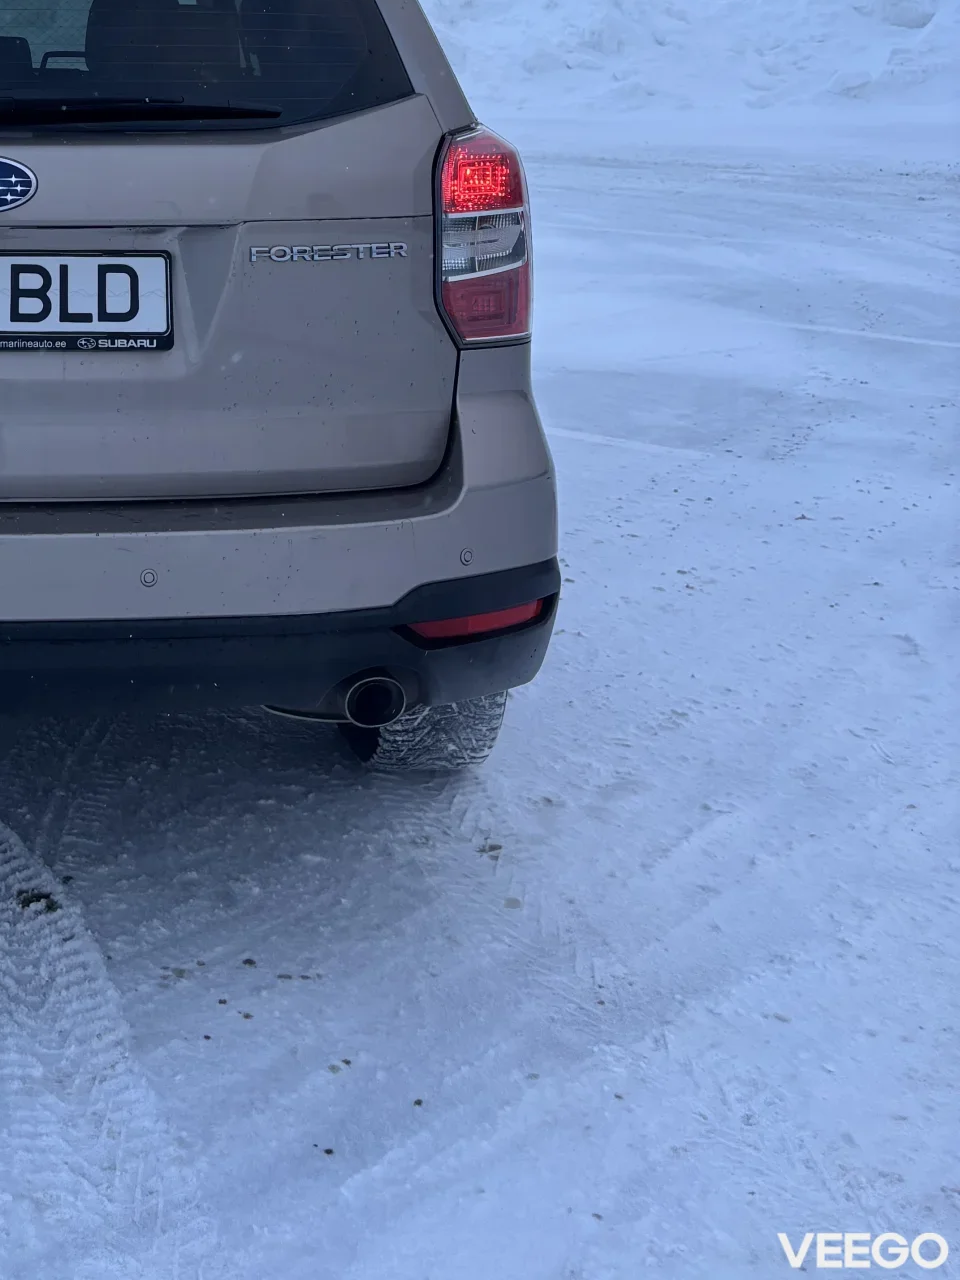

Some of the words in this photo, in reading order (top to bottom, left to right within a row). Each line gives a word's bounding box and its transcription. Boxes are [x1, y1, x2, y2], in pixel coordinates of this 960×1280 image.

[249, 242, 409, 262] FORESTER
[9, 263, 140, 323] BLD
[98, 339, 157, 348] SUBARU
